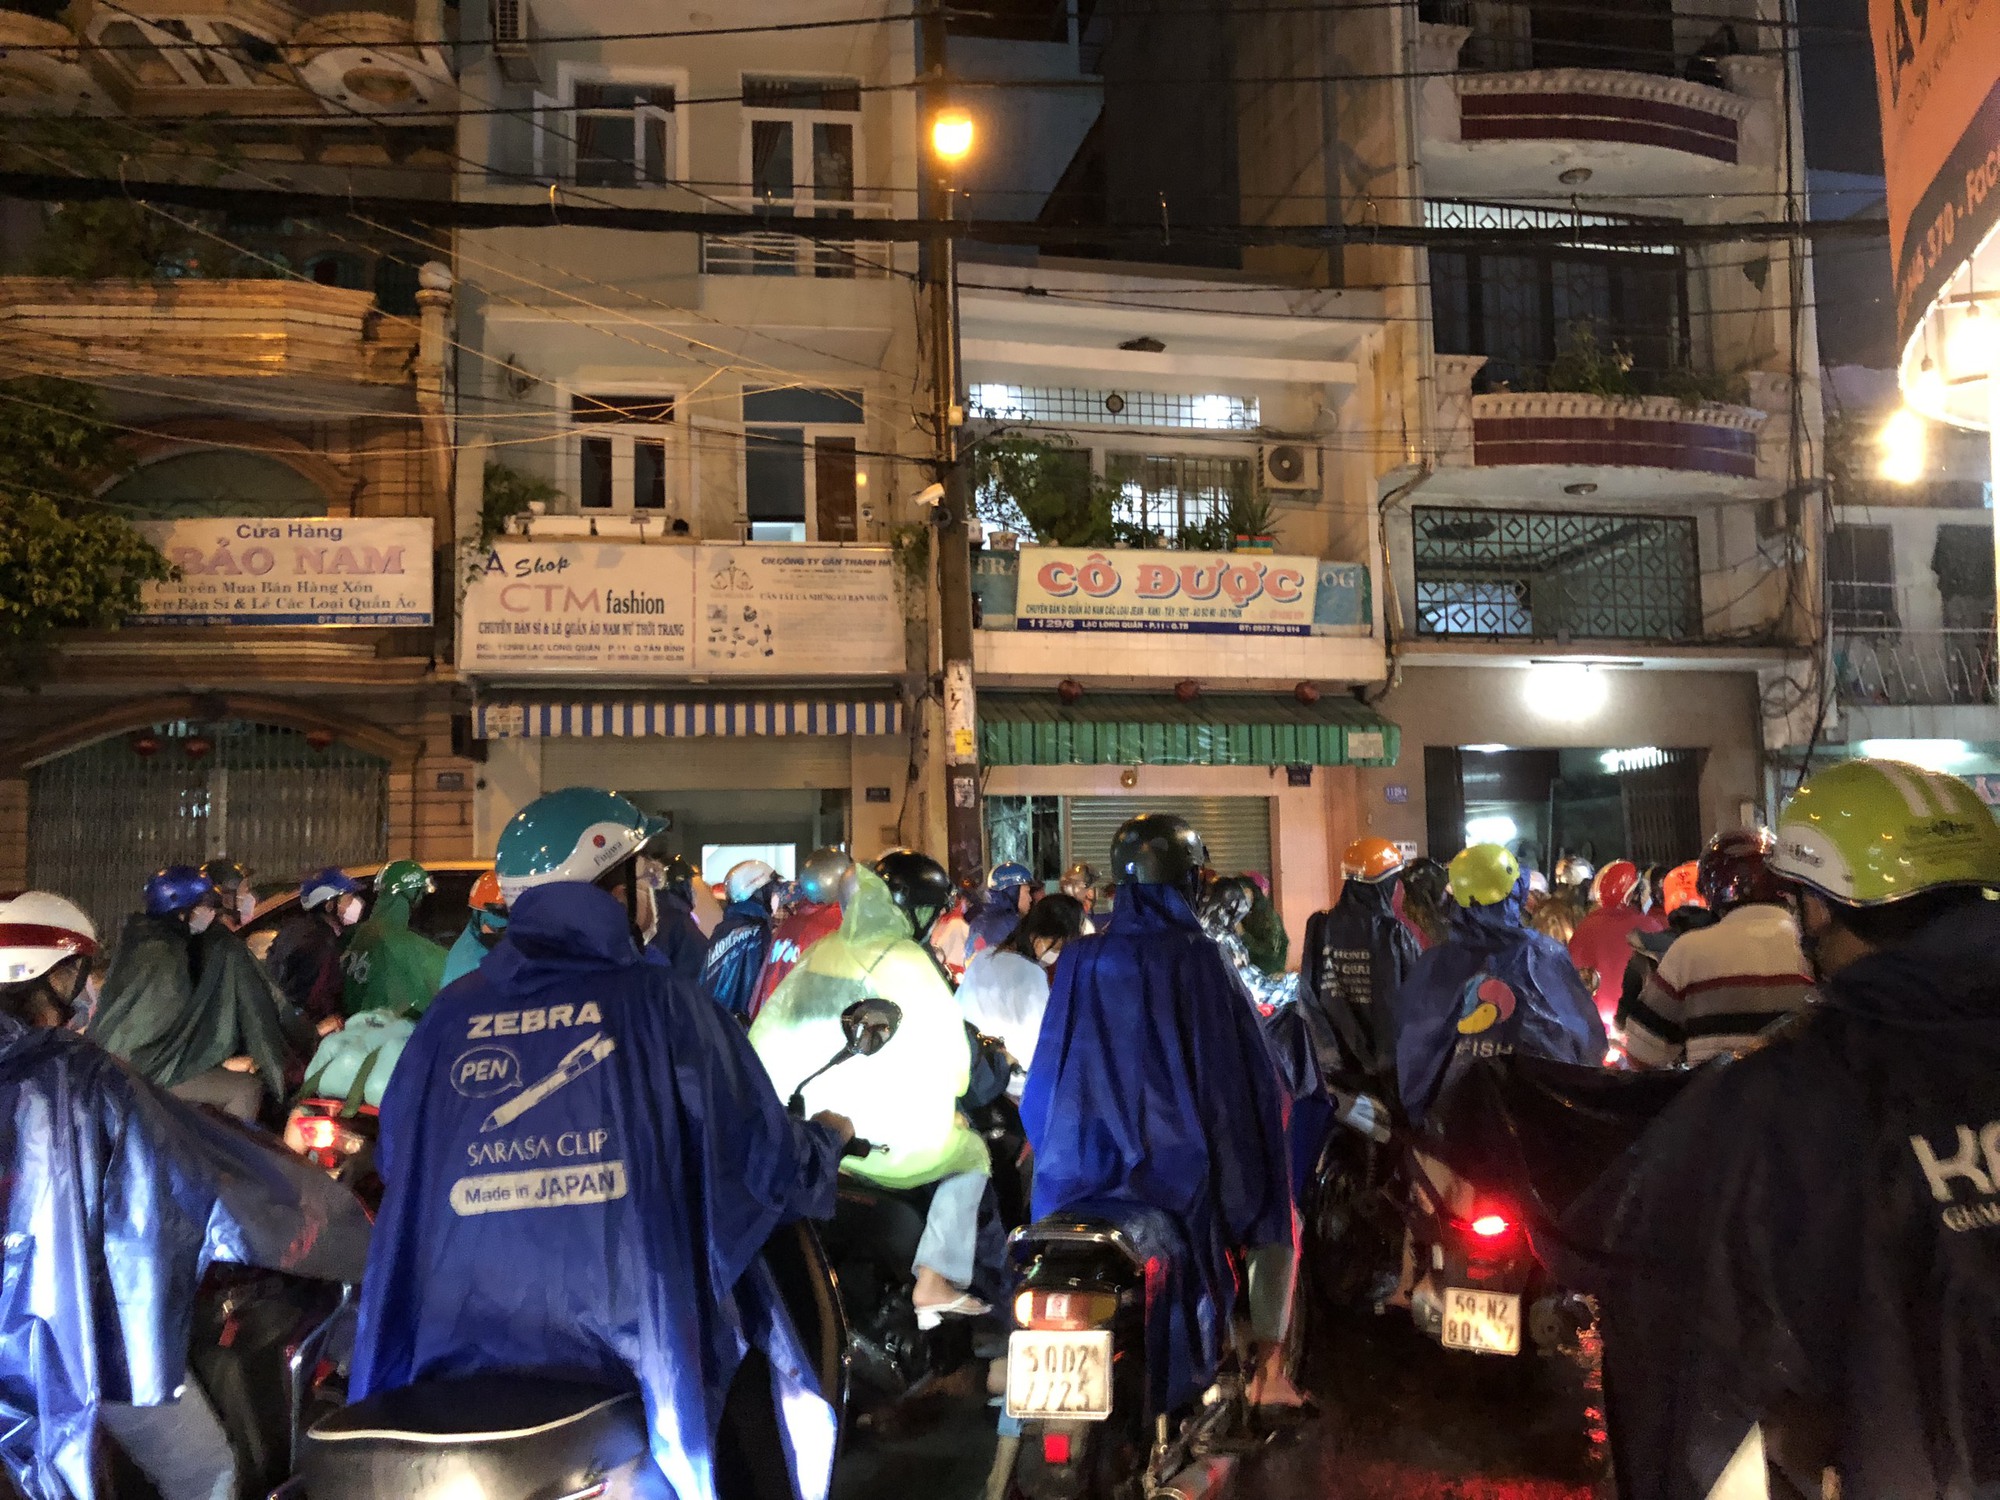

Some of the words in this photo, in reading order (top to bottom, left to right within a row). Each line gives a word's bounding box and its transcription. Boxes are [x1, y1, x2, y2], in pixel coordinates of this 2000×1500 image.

[236, 523, 280, 539] Cửa
[288, 523, 343, 541] Hàng
[293, 547, 406, 575] NAM
[515, 556, 570, 577] Shop
[223, 582, 256, 594] Mua
[297, 581, 338, 595] Hàng
[1037, 553, 1122, 598] CÔ
[1135, 558, 1304, 609] ĐƯỢC
[234, 598, 246, 610] &
[500, 583, 600, 613] CTM
[606, 589, 665, 614] fashion
[467, 1001, 602, 1040] ZEBRA
[461, 1058, 509, 1084] PEN
[467, 1134, 551, 1167] SARASA
[557, 1128, 608, 1157] CLIP
[465, 1185, 510, 1205] Made
[515, 1184, 529, 1199] in
[535, 1169, 615, 1201] JAPAN
